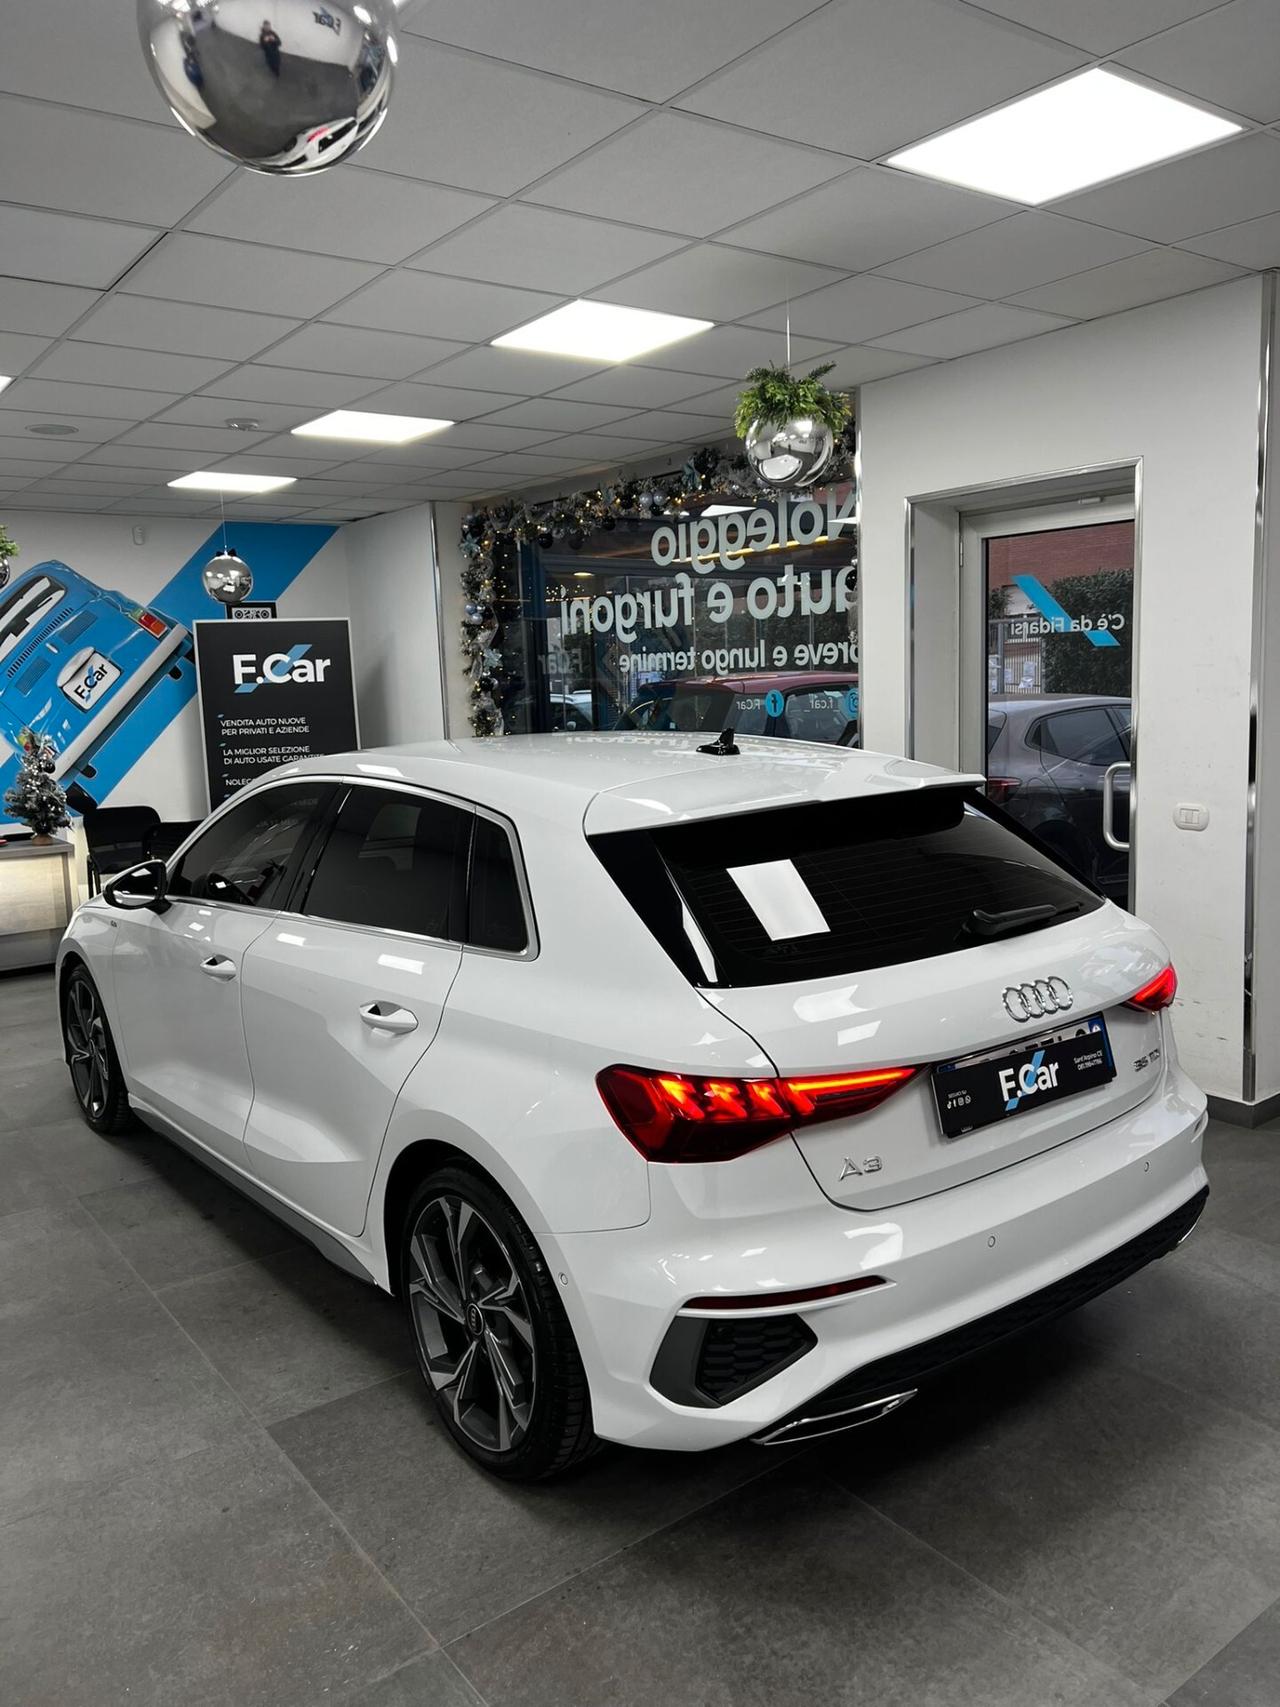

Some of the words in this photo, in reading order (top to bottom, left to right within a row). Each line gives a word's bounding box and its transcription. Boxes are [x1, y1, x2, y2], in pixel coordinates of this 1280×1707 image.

[233, 652, 331, 685] F.Car
[74, 664, 108, 699] F.Car
[220, 719, 255, 727] VENDITA
[255, 718, 277, 726] AUTO
[278, 717, 306, 725] NUOVE
[221, 728, 238, 736] PER
[239, 727, 268, 735] PRIVATI
[275, 725, 310, 734] AZIENDE
[234, 747, 267, 755] MIGLIOR
[268, 745, 310, 754] SELEZIONE
[223, 757, 233, 765] DI
[233, 757, 256, 765] AUTO
[256, 755, 281, 763] USATE
[999, 1060, 1059, 1102] F.Car
[839, 1156, 883, 1181] A3
